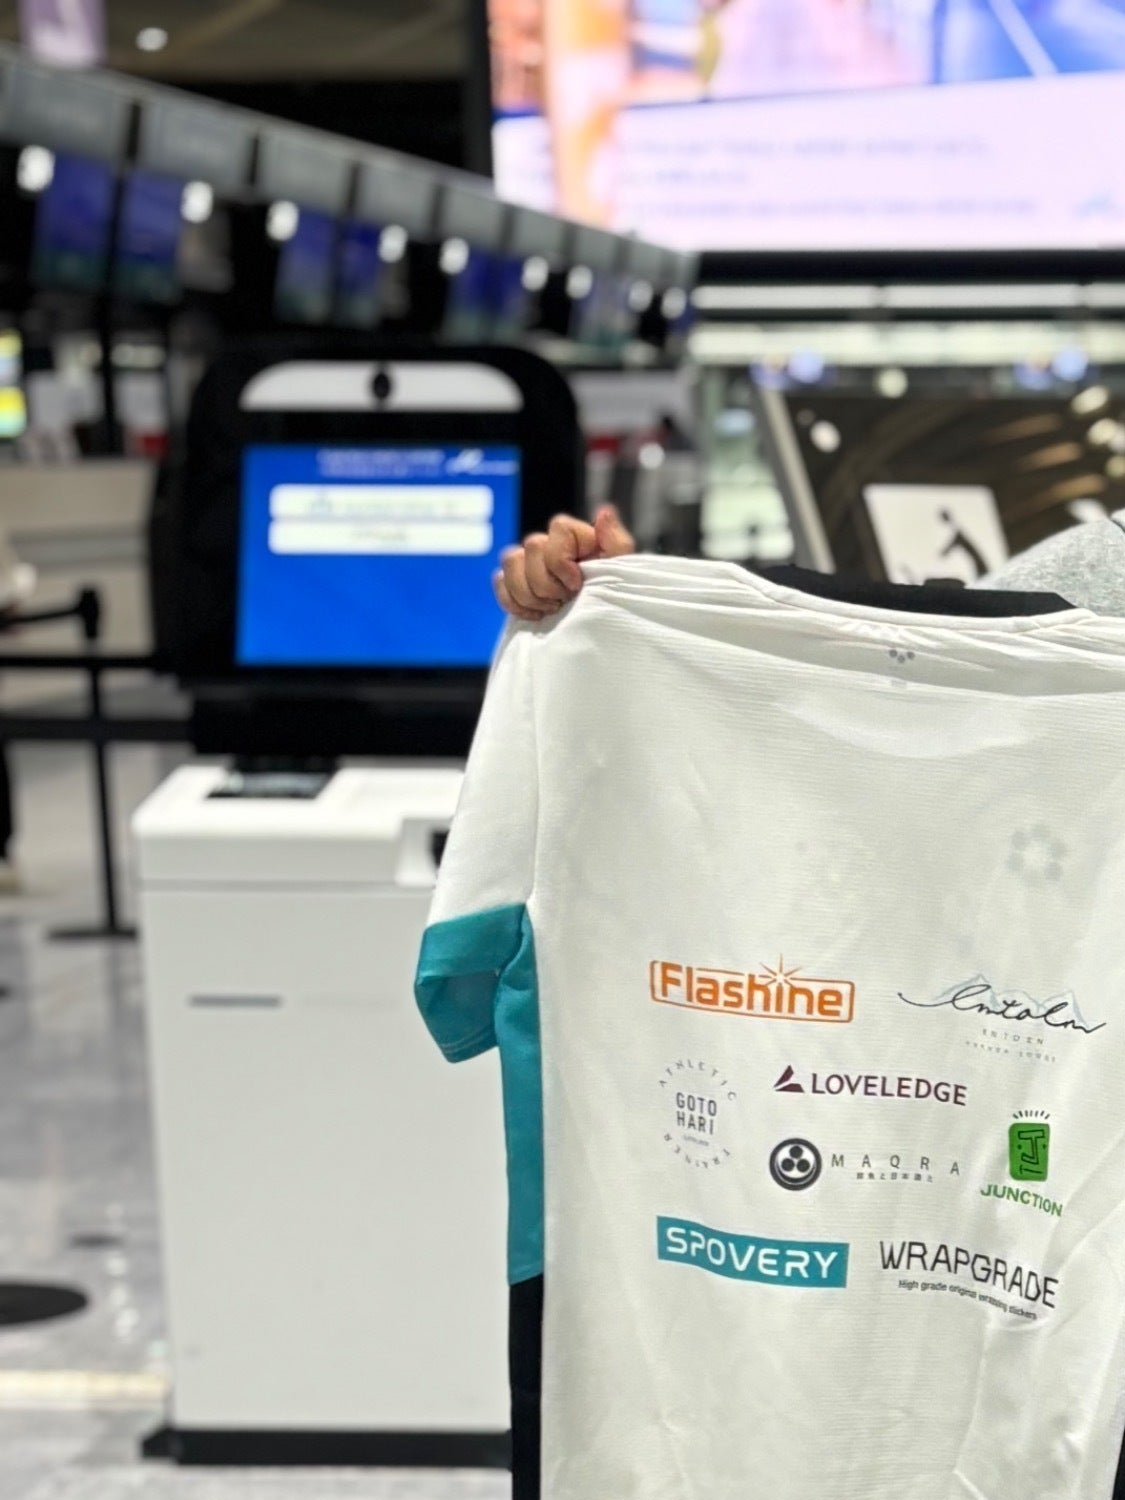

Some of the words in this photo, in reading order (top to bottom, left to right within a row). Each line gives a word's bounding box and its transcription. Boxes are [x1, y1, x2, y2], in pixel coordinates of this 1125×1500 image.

[660, 961, 844, 1017] Flashine
[675, 1091, 718, 1118] GOTO
[811, 1073, 967, 1107] LOVELEDGE
[676, 1110, 715, 1136] HARI
[830, 1153, 961, 1176] MAQRA
[980, 1184, 1063, 1217] JUNCTION
[666, 1226, 839, 1279] SPOVERY
[879, 1240, 1060, 1309] WRAPGRADE
[899, 1279, 919, 1292] High
[920, 1280, 948, 1292] grade
